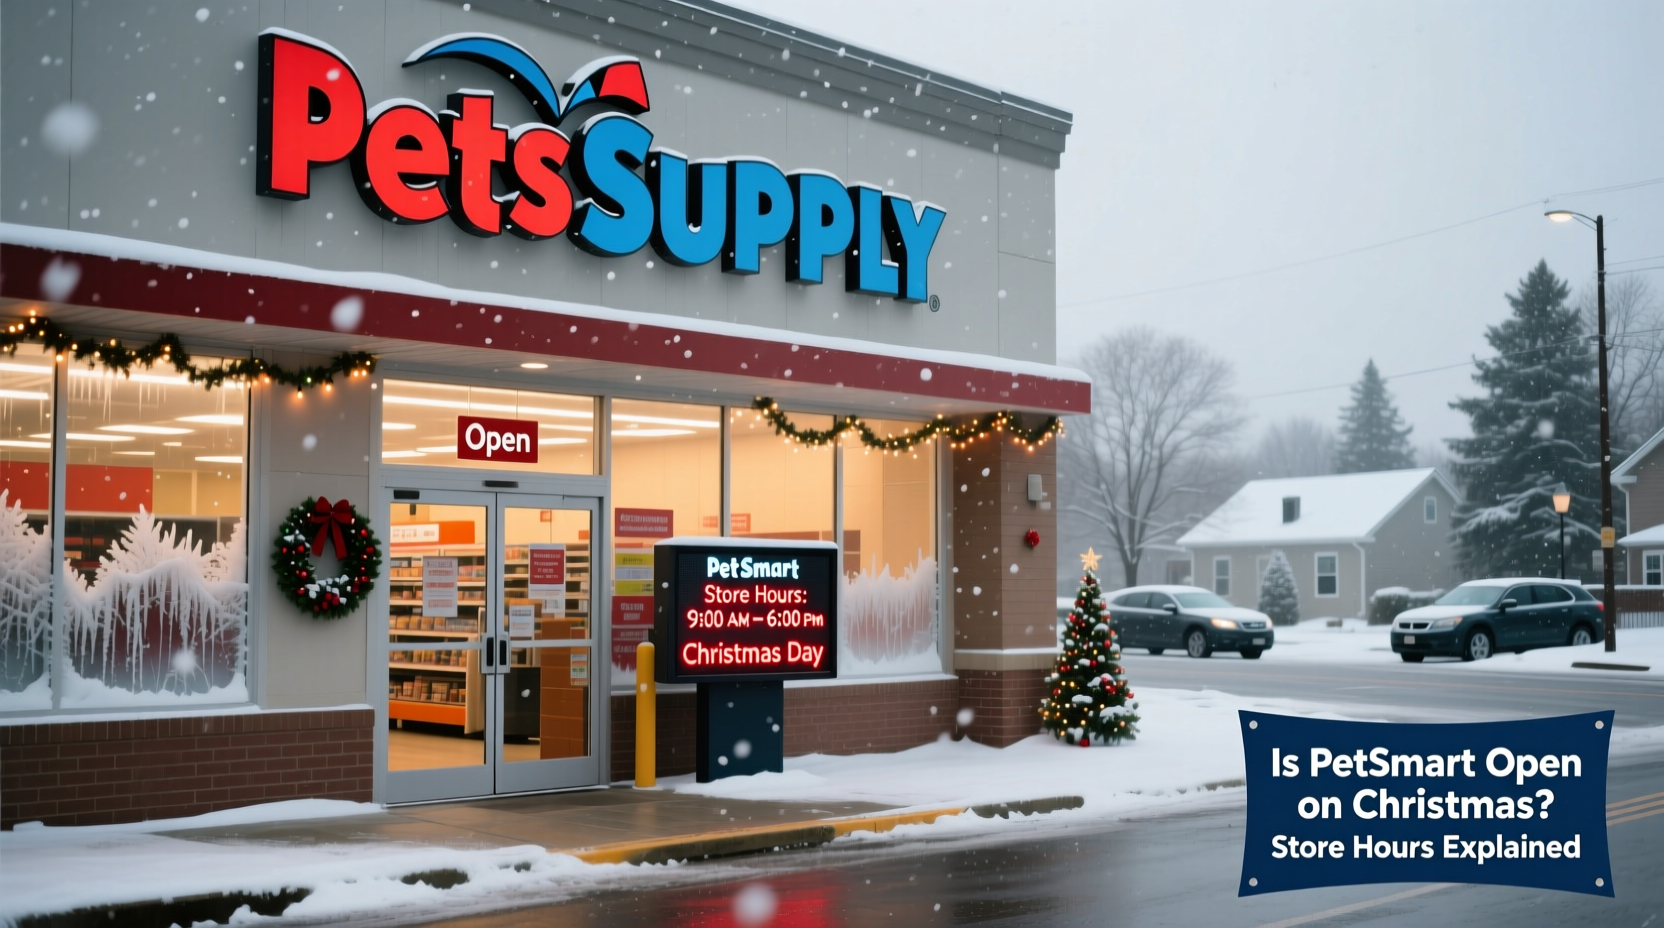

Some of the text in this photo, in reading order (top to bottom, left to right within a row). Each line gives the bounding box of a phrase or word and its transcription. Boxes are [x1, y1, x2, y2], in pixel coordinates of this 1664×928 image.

[465, 422, 531, 458] Open
[706, 556, 800, 580] PetSmart
[704, 584, 807, 604] Store Hours:
[686, 609, 724, 629] 9:00
[726, 611, 750, 628] AM
[766, 609, 801, 628] 6:00
[682, 640, 824, 669] Christmas Day
